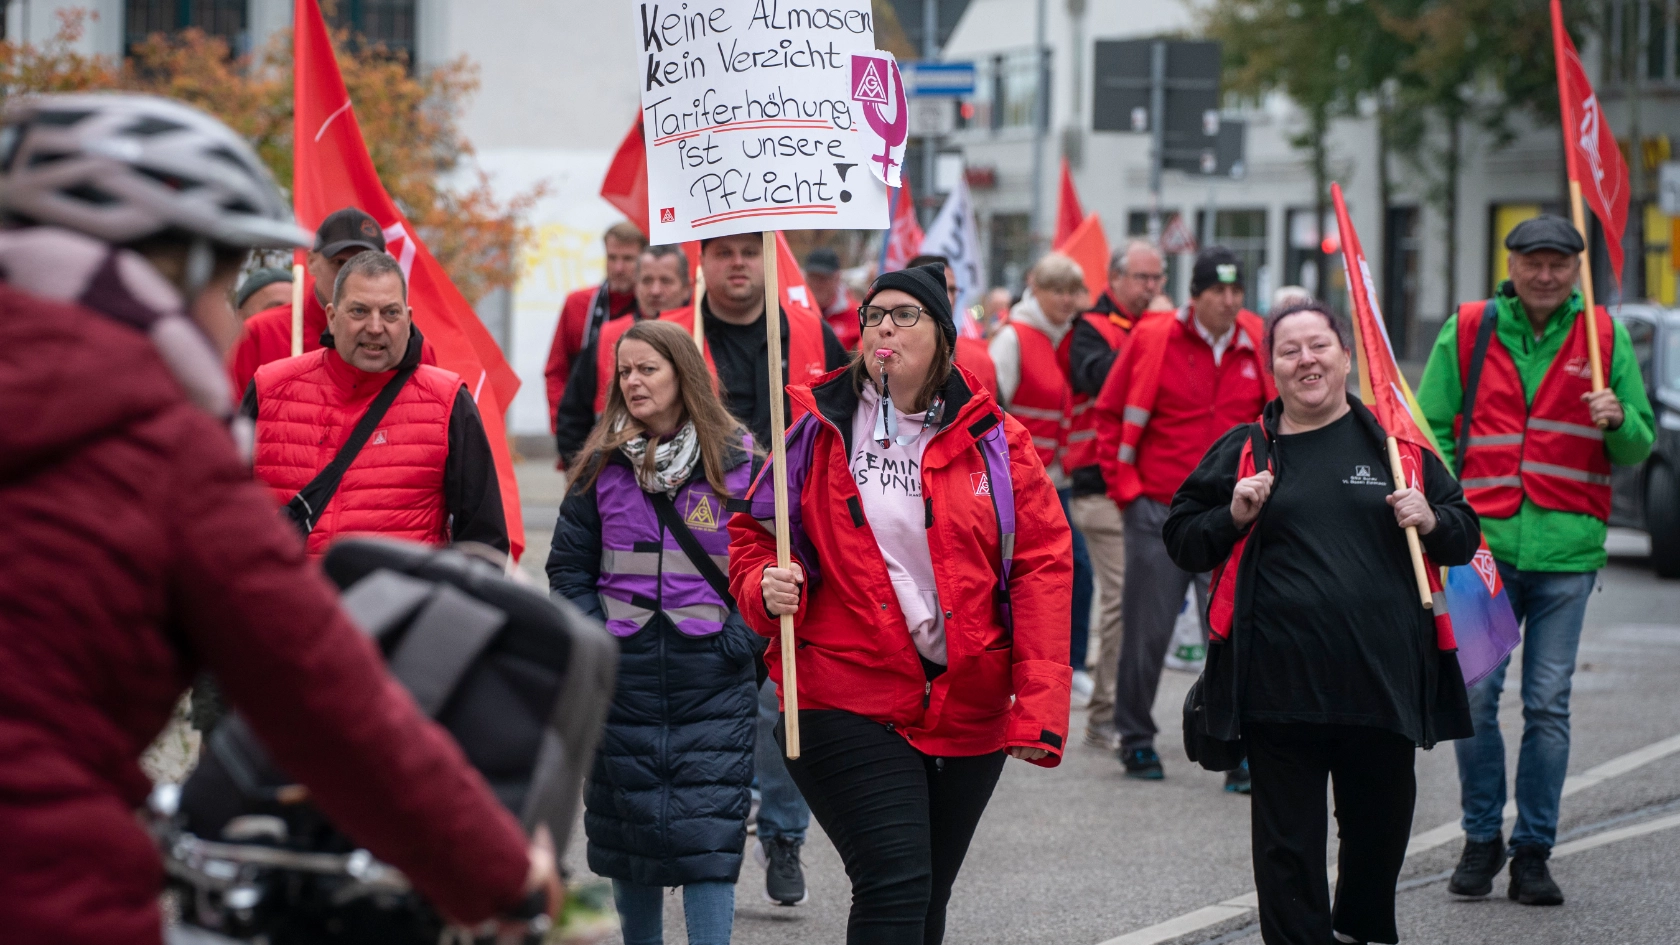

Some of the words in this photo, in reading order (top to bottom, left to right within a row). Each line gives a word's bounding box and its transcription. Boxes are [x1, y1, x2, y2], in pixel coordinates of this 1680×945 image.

[641, 3, 732, 52] Keine
[717, 38, 844, 74] Verzicht
[645, 86, 853, 139] Tariferhöhung
[678, 134, 723, 170] ist
[742, 135, 846, 160] unsere
